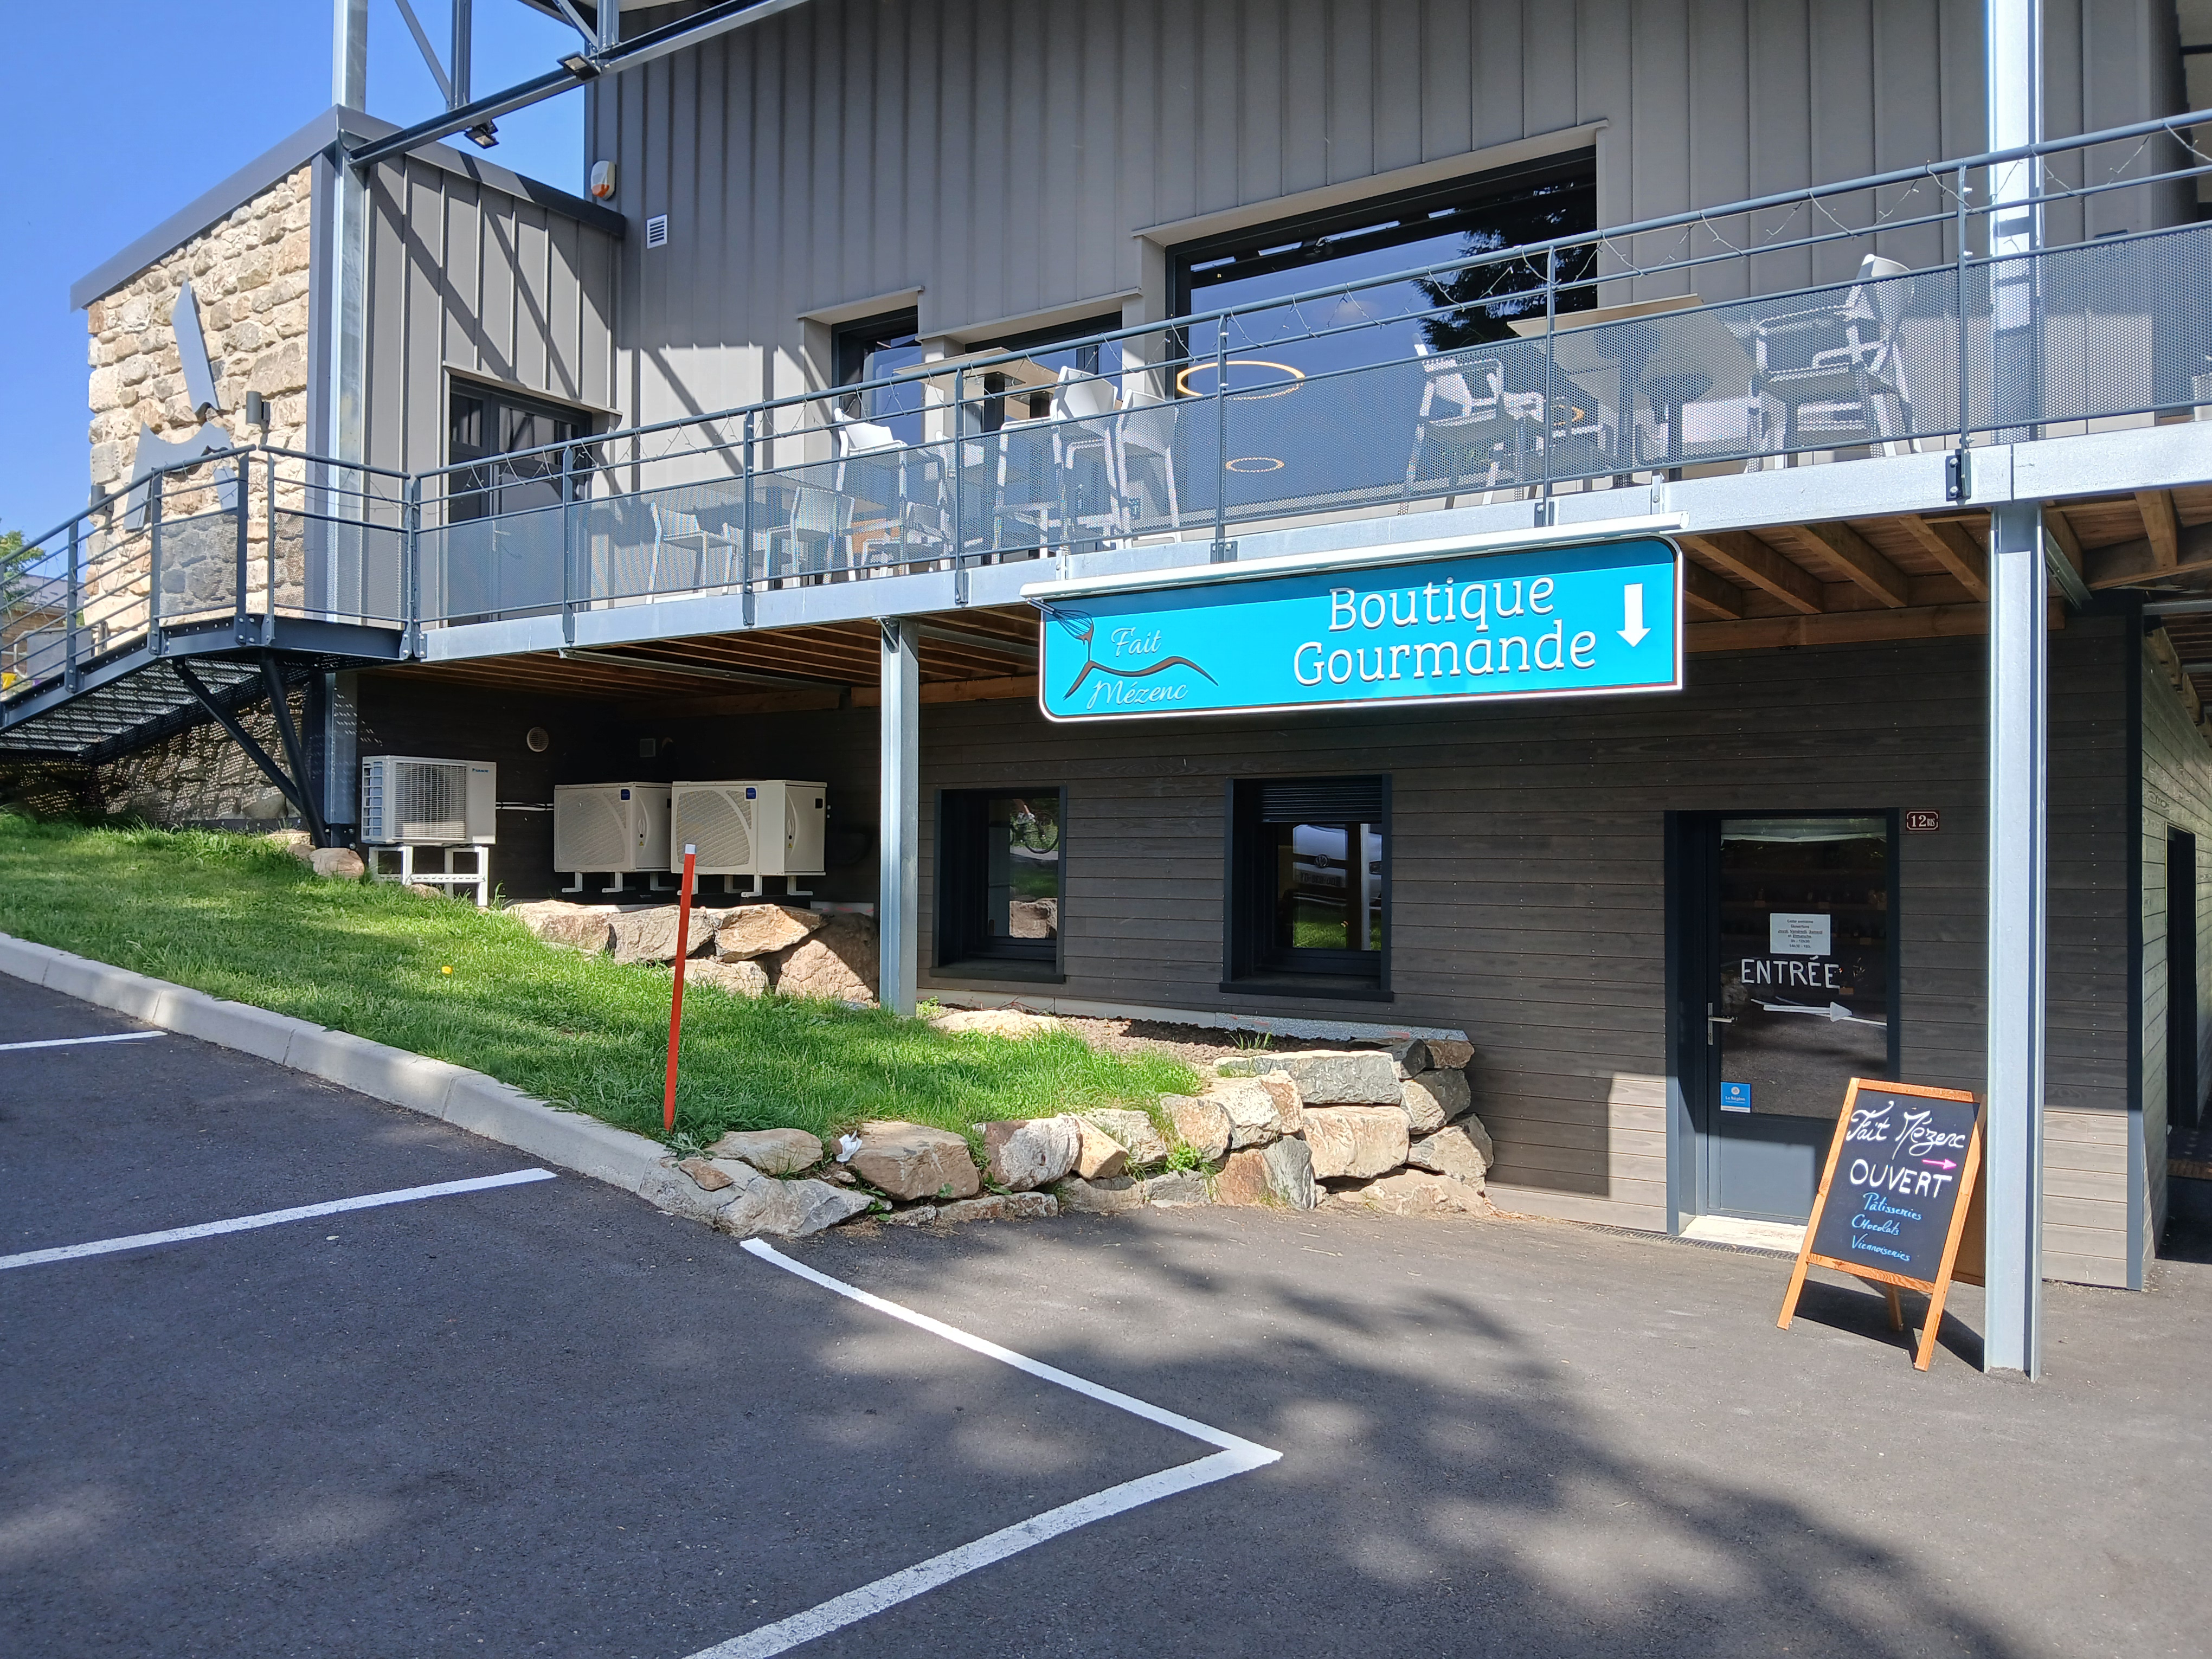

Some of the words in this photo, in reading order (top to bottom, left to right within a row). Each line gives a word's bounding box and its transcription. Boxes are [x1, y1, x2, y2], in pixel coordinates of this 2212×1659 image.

[1328, 577, 1554, 632] Boutique
[1111, 627, 1162, 657] Fait
[1293, 619, 1596, 686] Gourmande
[1086, 680, 1188, 710] Mézenc
[1741, 955, 1840, 989] ENTRÉE
[1846, 1101, 1894, 1141] Fait
[1891, 1110, 1965, 1160] Mézenc
[1850, 1159, 1952, 1198] OUVERT
[1863, 1192, 1922, 1220] Pâtisseries
